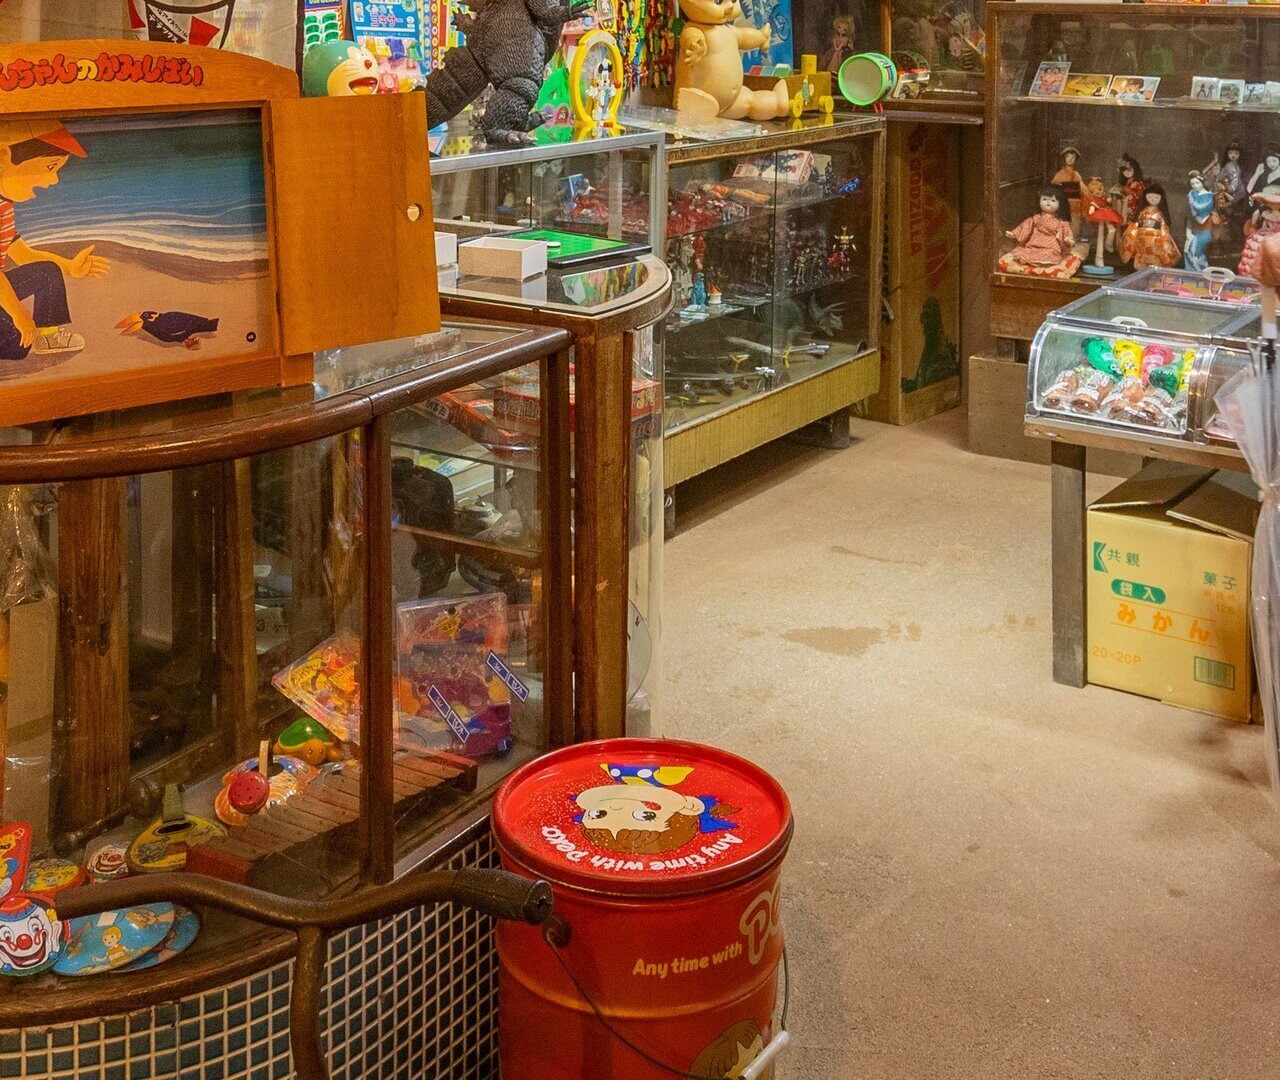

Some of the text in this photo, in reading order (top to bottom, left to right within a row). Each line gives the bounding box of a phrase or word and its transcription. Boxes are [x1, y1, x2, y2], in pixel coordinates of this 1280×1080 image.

[1119, 581, 1157, 602] 袋入
[1117, 603, 1210, 643] みかん
[700, 832, 744, 856] Any
[591, 853, 644, 873] with
[650, 851, 700, 872] time
[632, 957, 669, 979] Any
[671, 953, 710, 974] time
[712, 940, 743, 965] with
